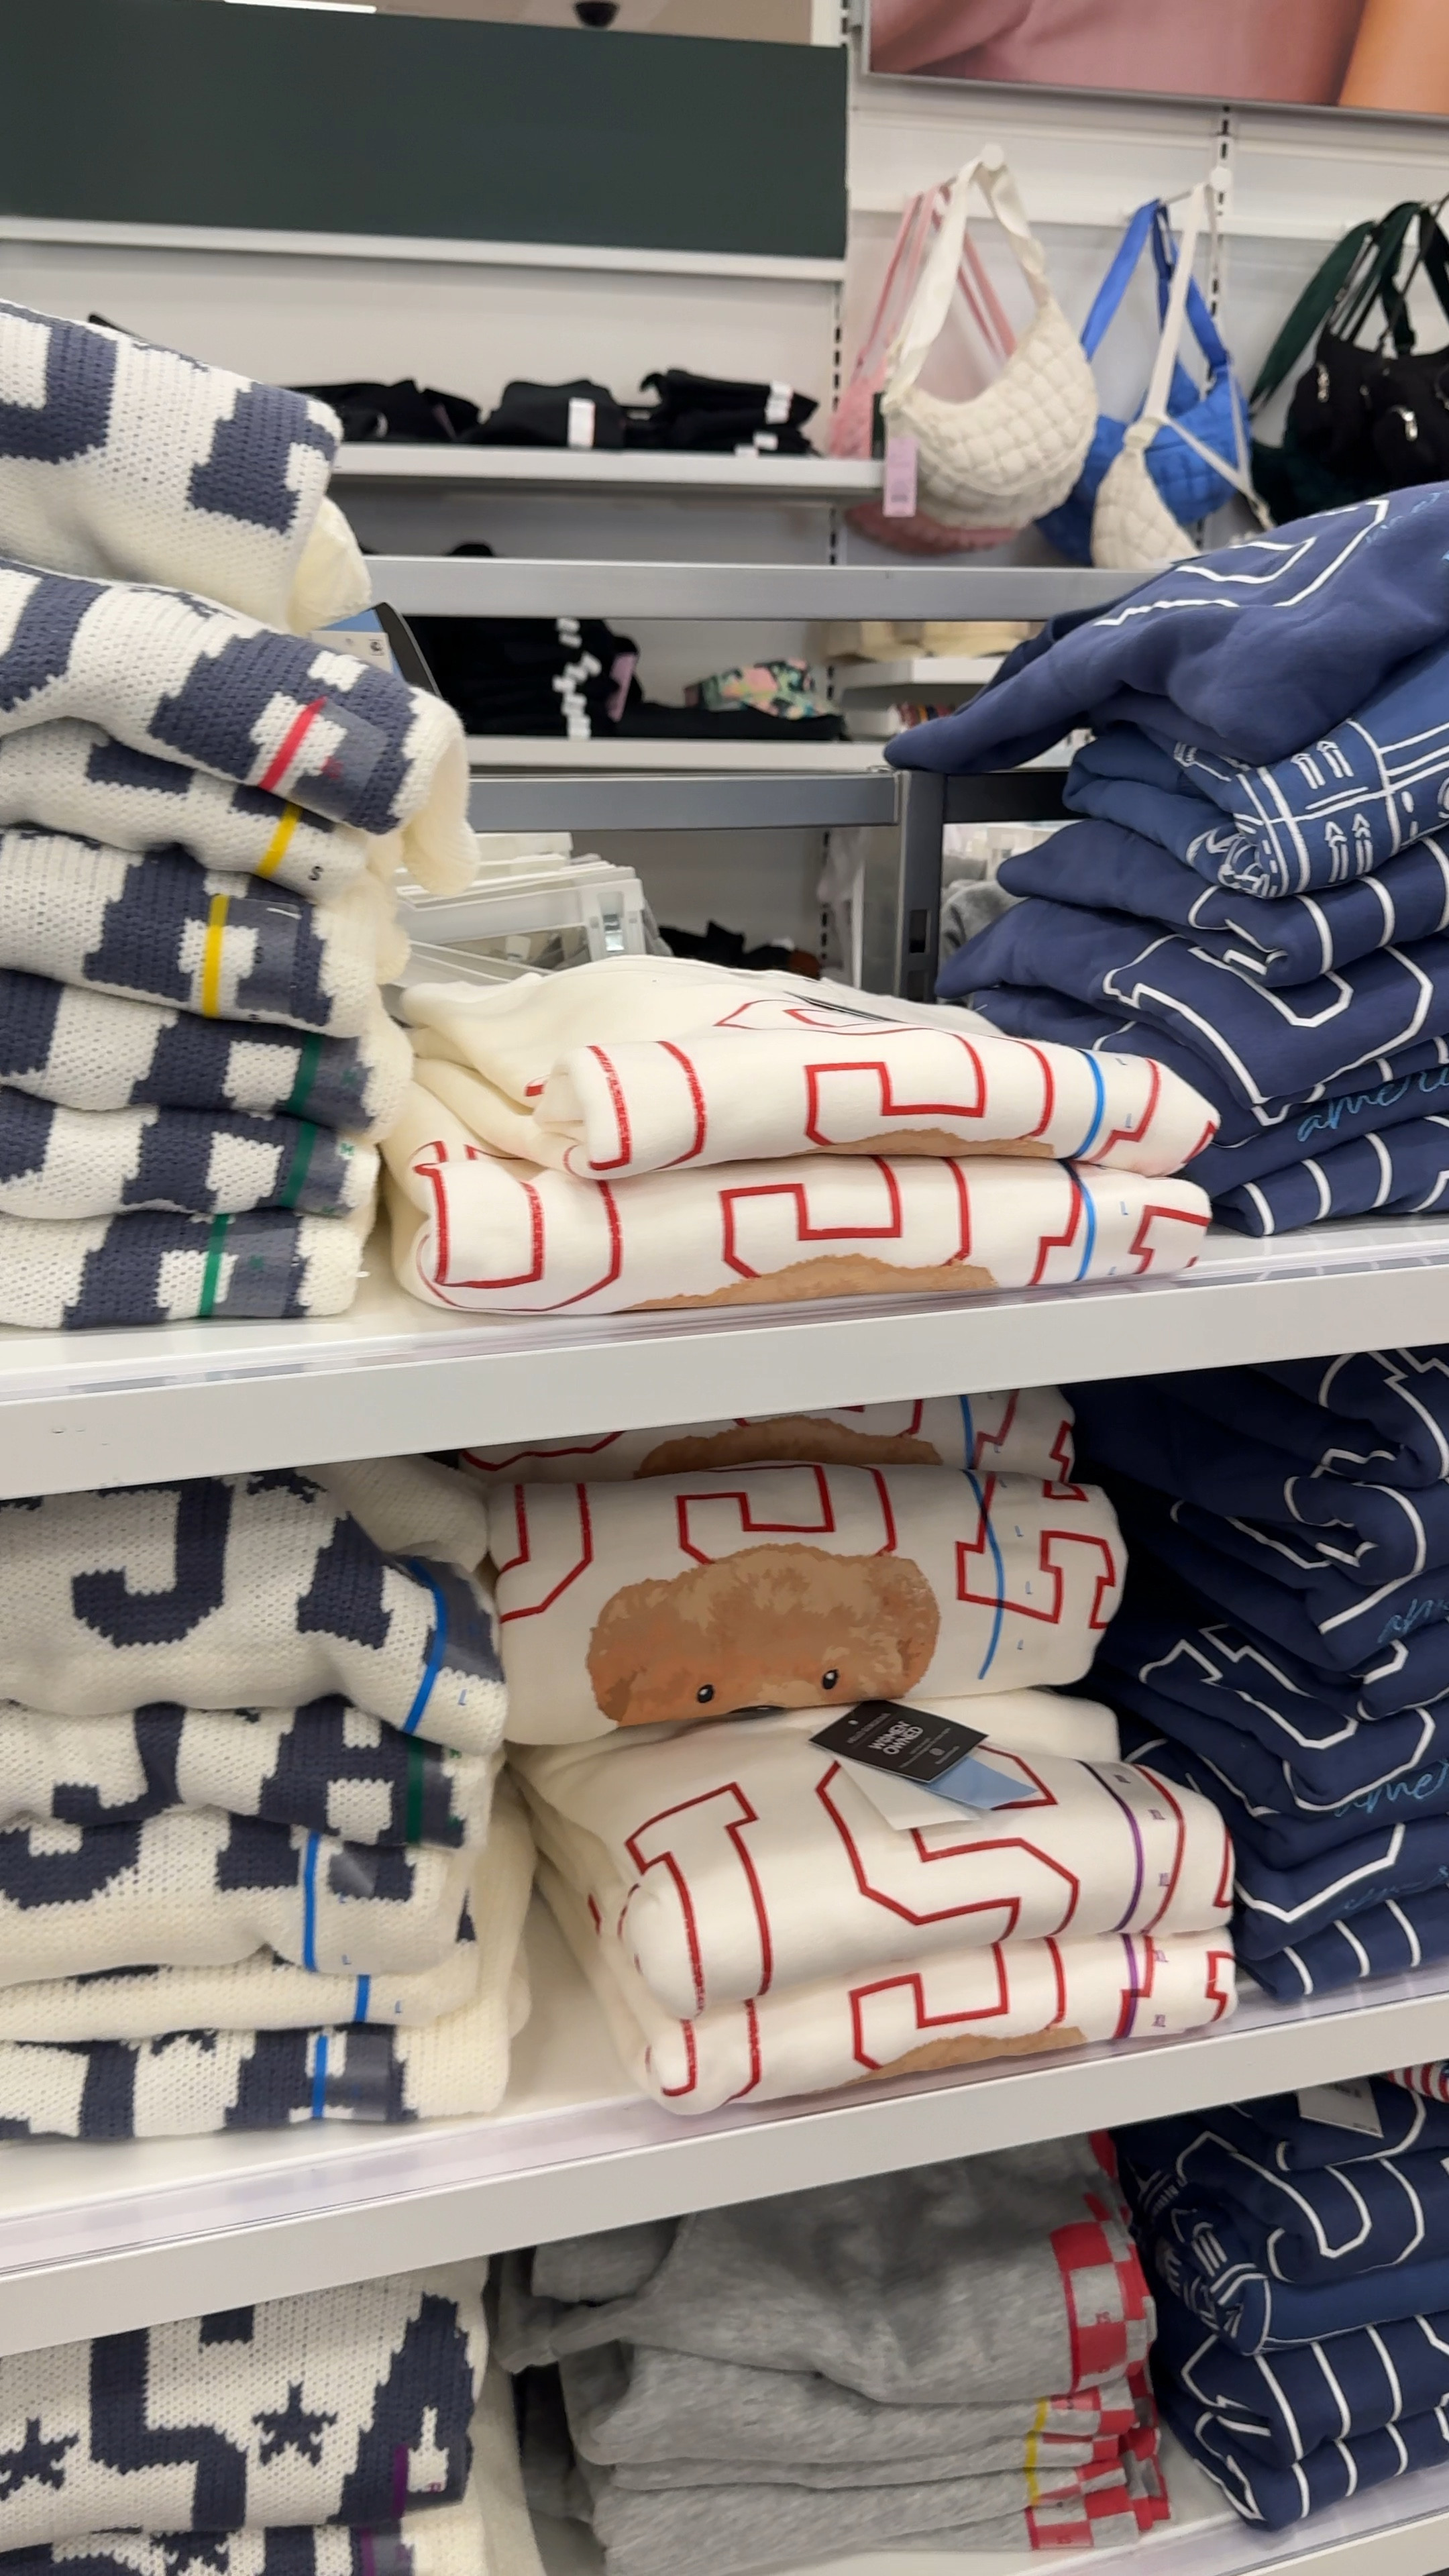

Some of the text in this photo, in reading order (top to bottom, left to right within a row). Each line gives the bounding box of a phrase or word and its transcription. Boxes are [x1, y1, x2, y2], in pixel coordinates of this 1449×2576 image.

[308, 865, 323, 881] S
[1124, 1112, 1132, 1128] L
[1120, 1201, 1129, 1216] L
[1014, 1525, 1024, 1538] L
[1024, 1580, 1032, 1595] L
[458, 1688, 468, 1706] L
[868, 1721, 911, 1750] WOMEN
[883, 1726, 924, 1755] OWNED
[341, 1954, 352, 1966] L
[394, 1999, 402, 2014] L
